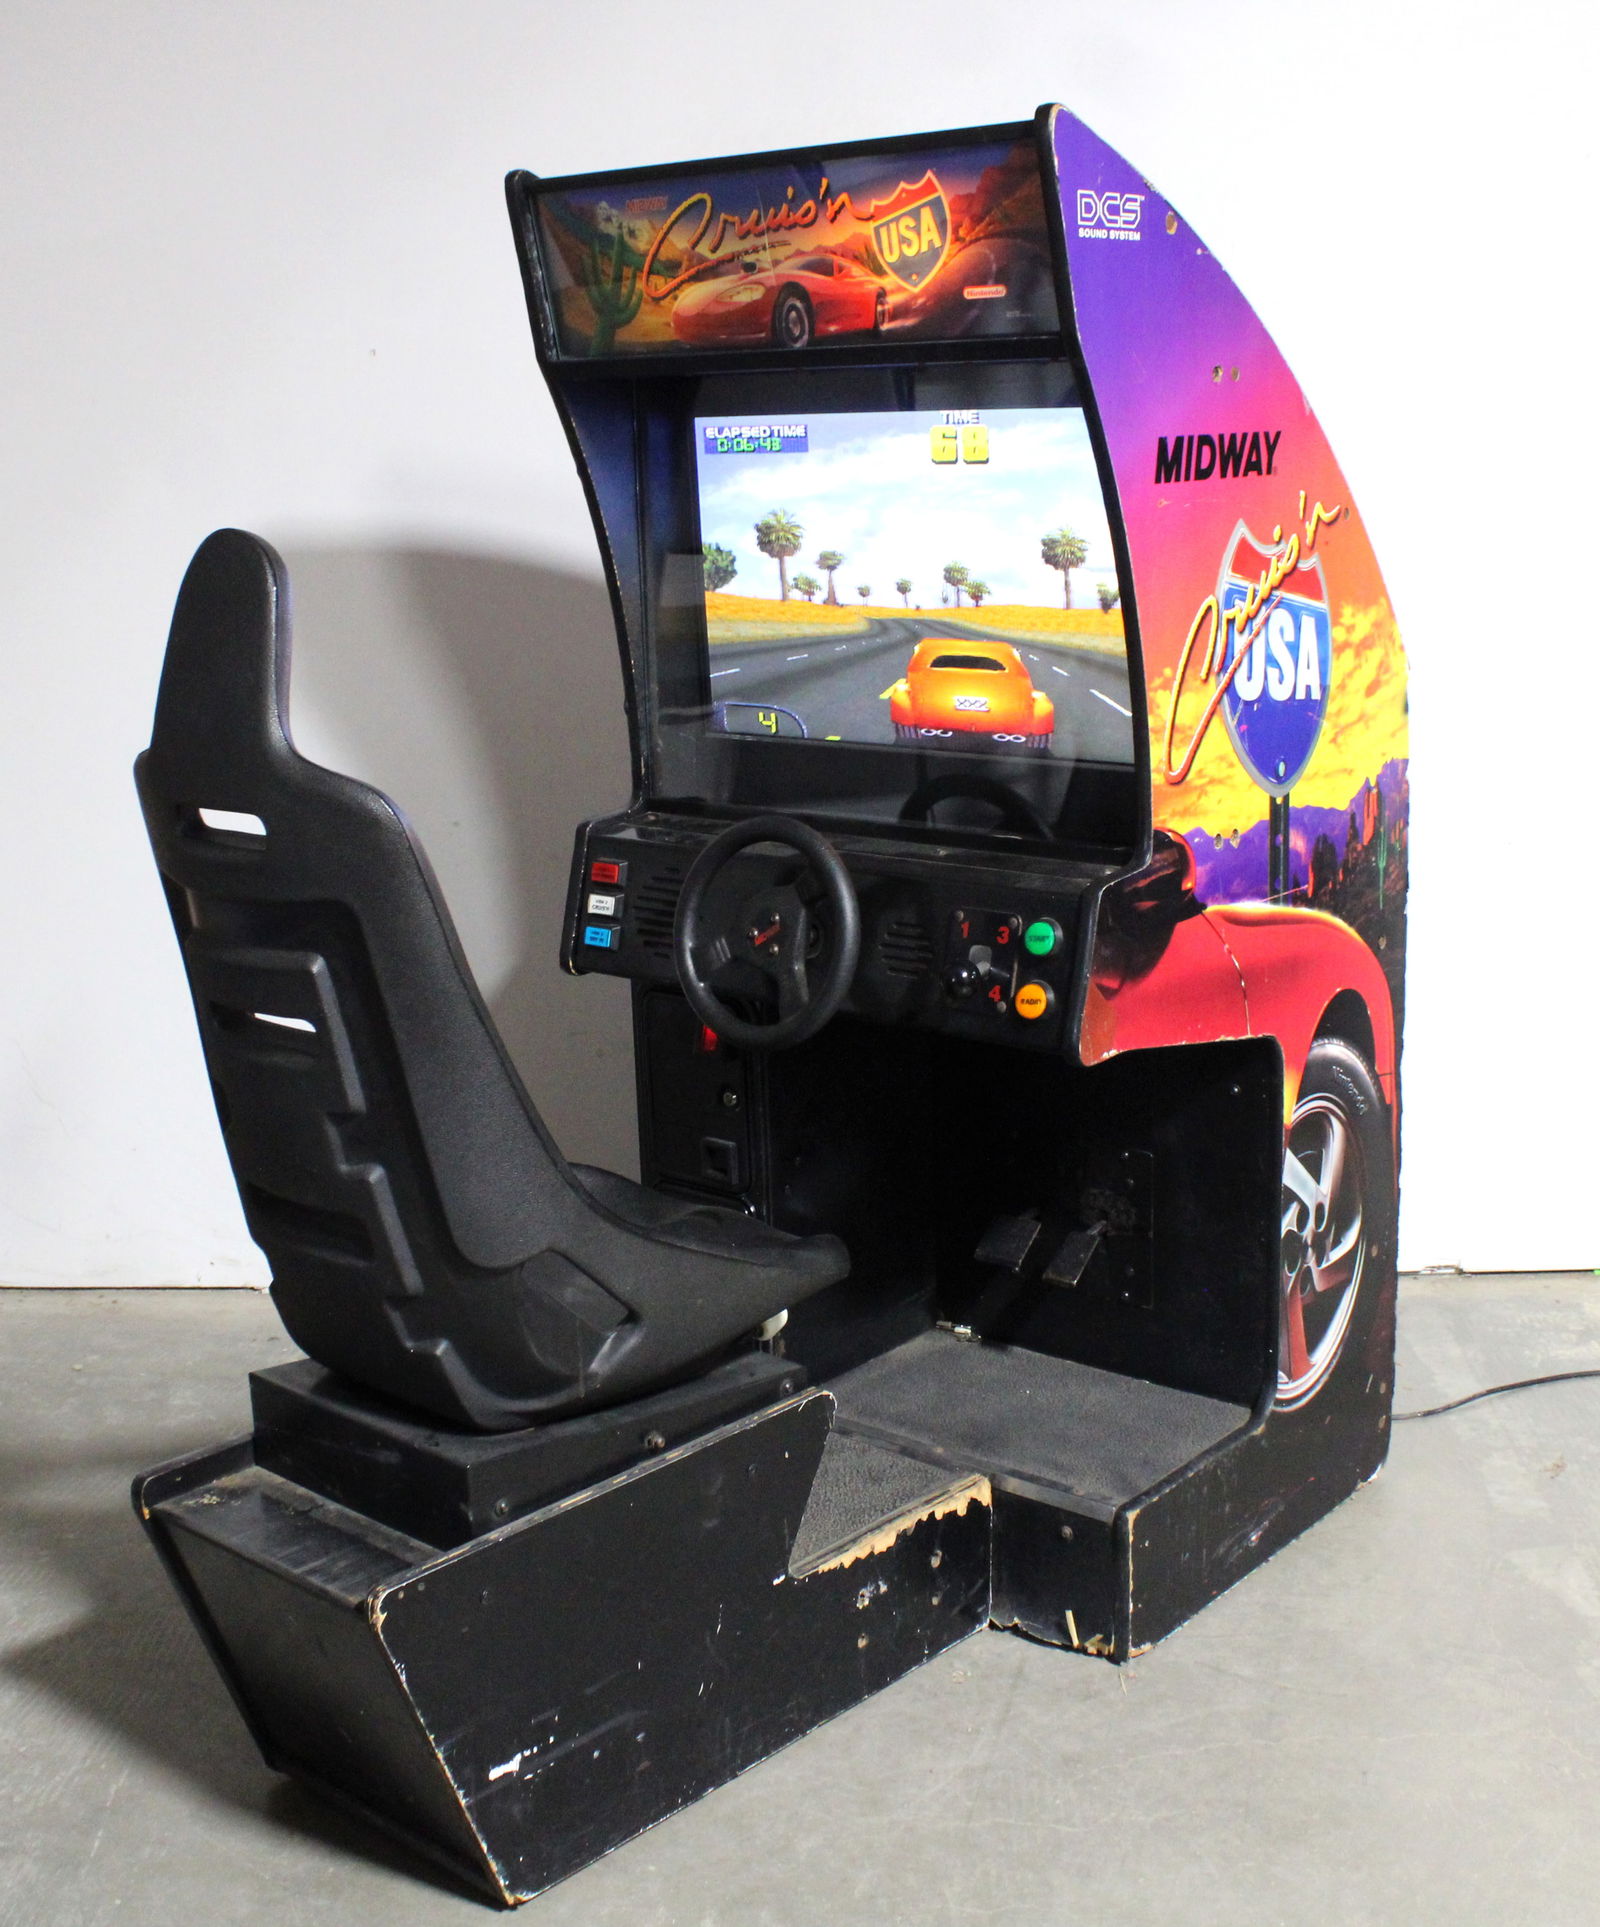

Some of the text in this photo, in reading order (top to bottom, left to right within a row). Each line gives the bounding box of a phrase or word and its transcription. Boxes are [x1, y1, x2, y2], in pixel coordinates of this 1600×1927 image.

[643, 176, 942, 299] Cruis'n USA
[1078, 227, 1141, 241] SOUND SYSTEM
[966, 286, 1005, 298] Nintendo
[940, 410, 980, 425] TIME
[705, 424, 806, 439] ELAPSED TIME
[930, 425, 989, 465] 68
[1154, 430, 1282, 484] MIDWAY
[1163, 489, 1341, 785] Cruis'n
[1233, 603, 1321, 702] USA
[758, 711, 778, 734] 4
[961, 921, 970, 938] 1
[996, 925, 1010, 944] 3
[988, 985, 1001, 1002] 4
